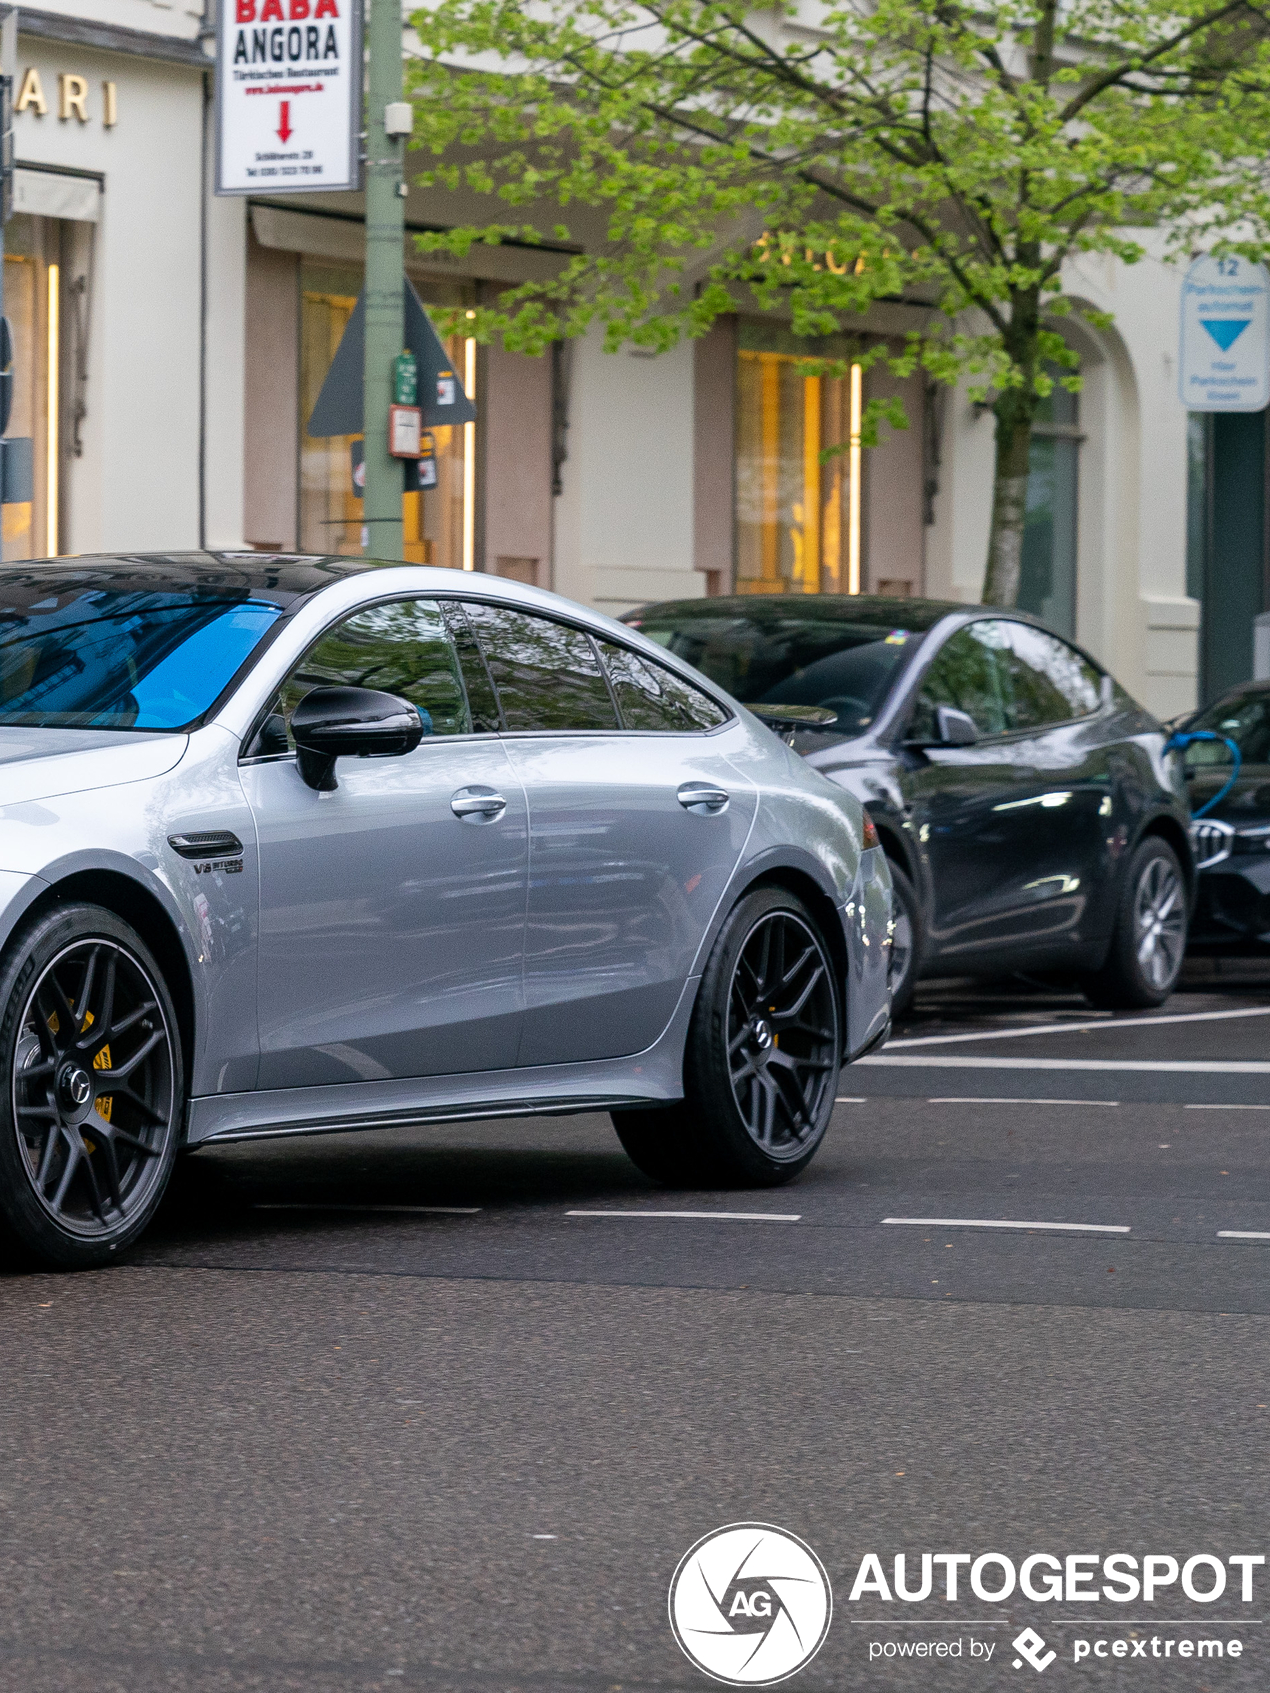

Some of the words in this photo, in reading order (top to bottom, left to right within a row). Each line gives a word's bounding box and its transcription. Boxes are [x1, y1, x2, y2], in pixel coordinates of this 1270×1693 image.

[235, 0, 339, 23] BABA
[234, 24, 339, 64] ANGORA
[287, 67, 339, 78] Restaurant
[193, 863, 212, 874] V8
